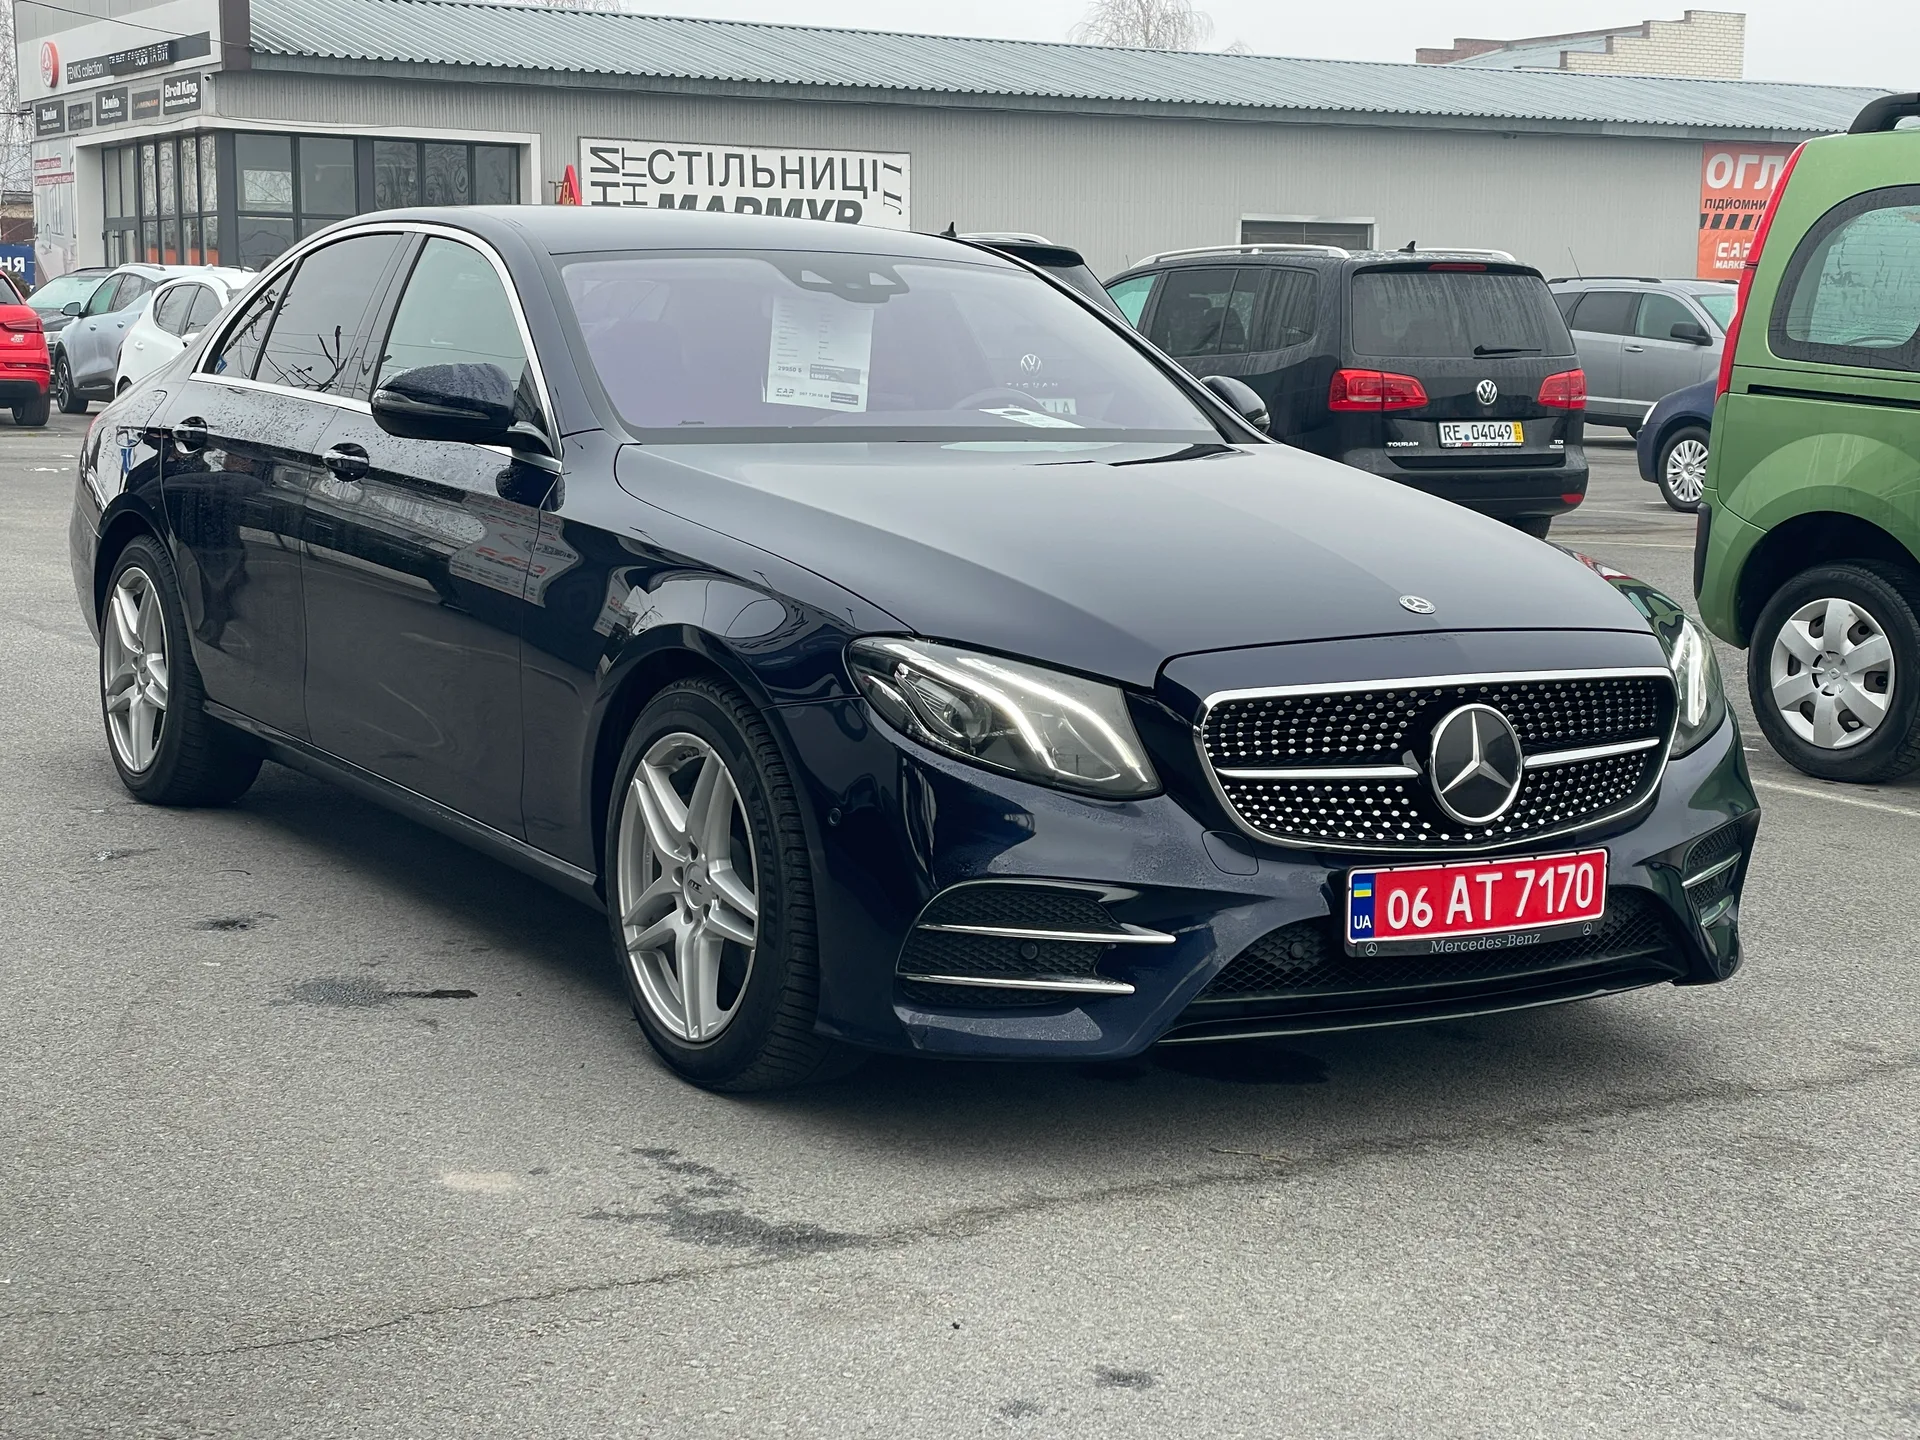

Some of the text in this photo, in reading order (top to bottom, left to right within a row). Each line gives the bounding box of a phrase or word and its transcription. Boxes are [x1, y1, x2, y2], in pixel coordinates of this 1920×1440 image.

[165, 79, 198, 97] Broil King
[648, 149, 878, 199] СТІЛЬНИЦІ
[1706, 153, 1785, 190] ОГЛ
[1443, 424, 1512, 441] RE 04049
[1387, 862, 1594, 930] 06 AT 7170
[1354, 915, 1372, 930] UA
[1430, 932, 1540, 954] Mercedes-Benz
